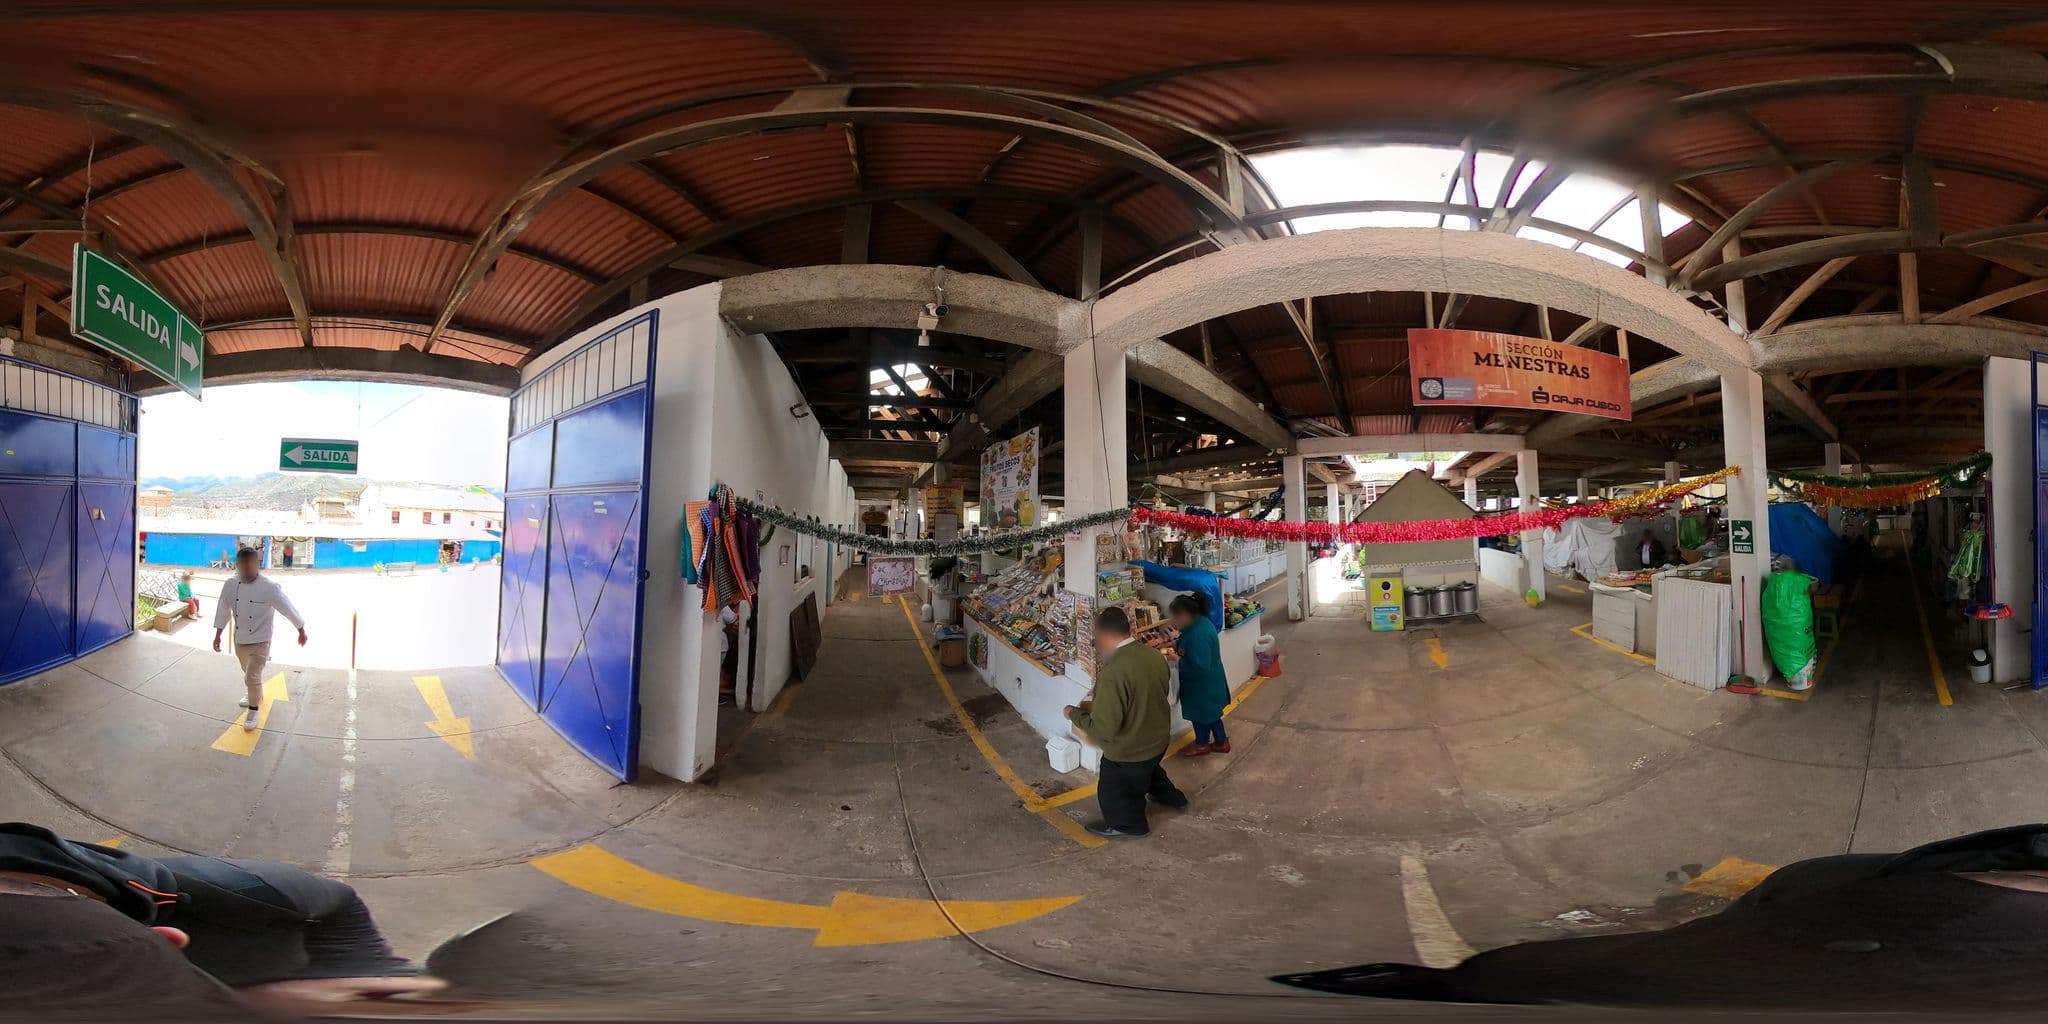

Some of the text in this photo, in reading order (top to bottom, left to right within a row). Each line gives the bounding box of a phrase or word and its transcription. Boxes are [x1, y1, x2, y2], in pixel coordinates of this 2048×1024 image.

[96, 284, 170, 349] SALIDA
[1506, 341, 1563, 360] SECCIÓN
[1474, 352, 1590, 379] MENESTRAS
[1551, 394, 1621, 412] CAJA CUSCO
[303, 450, 349, 462] SALIDA
[1734, 545, 1752, 553] SALIDA
